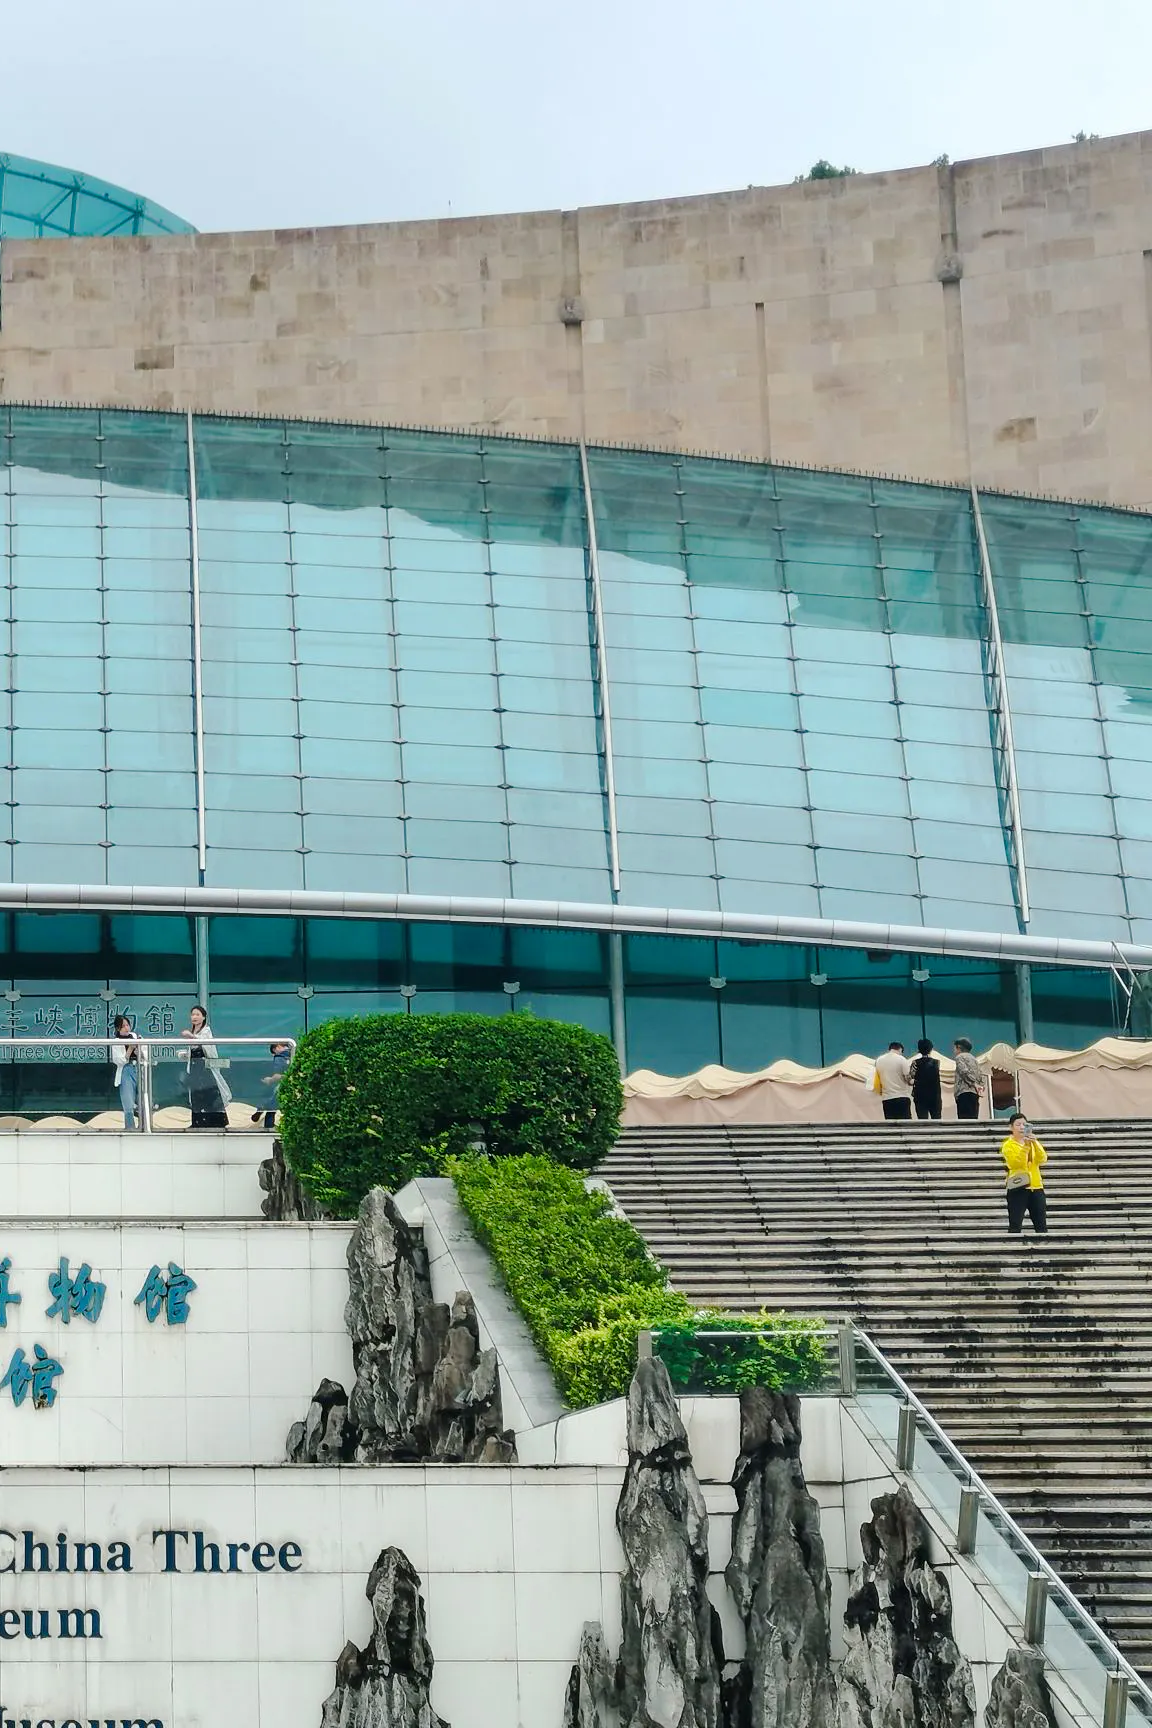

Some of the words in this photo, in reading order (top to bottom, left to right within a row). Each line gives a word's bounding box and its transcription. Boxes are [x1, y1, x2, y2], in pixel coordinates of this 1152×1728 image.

[0, 1045, 45, 1060] Three
[49, 1044, 107, 1061] Gorges
[152, 1529, 302, 1573] Three
